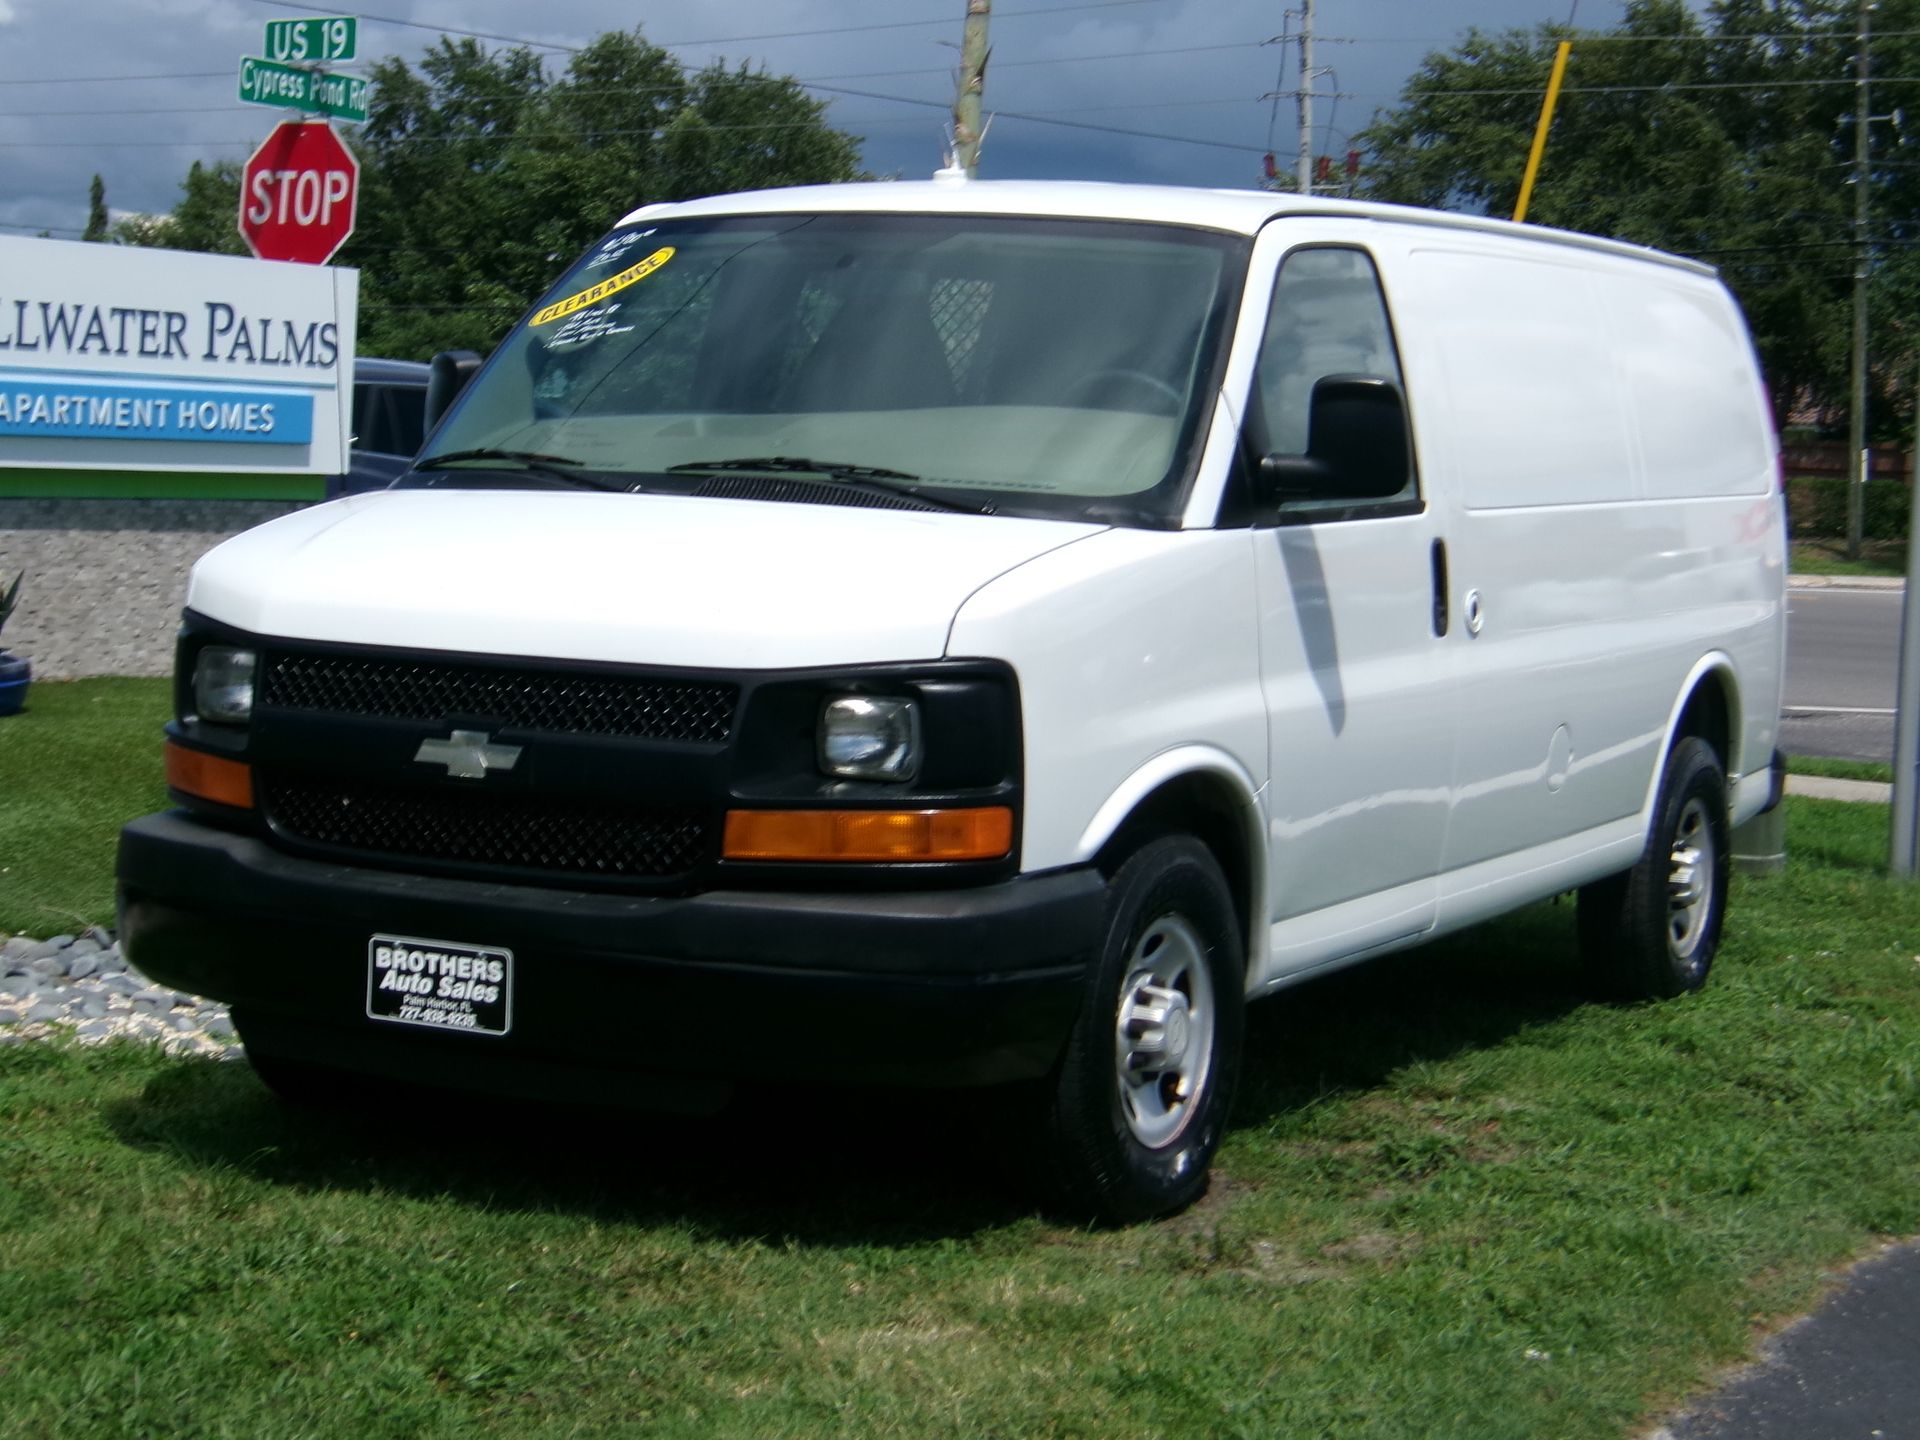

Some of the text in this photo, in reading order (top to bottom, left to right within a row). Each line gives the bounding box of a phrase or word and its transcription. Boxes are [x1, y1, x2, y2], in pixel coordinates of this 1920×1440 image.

[273, 20, 348, 61] US 19
[241, 61, 366, 111] Cypress Pond Rd
[248, 169, 349, 226] STOP
[540, 256, 662, 322] CLEARANCE
[203, 301, 339, 369] PALMS
[0, 393, 276, 433] APARTMENT HOMES
[375, 946, 503, 983] BROTHERS
[379, 968, 499, 1003] Auto Sales
